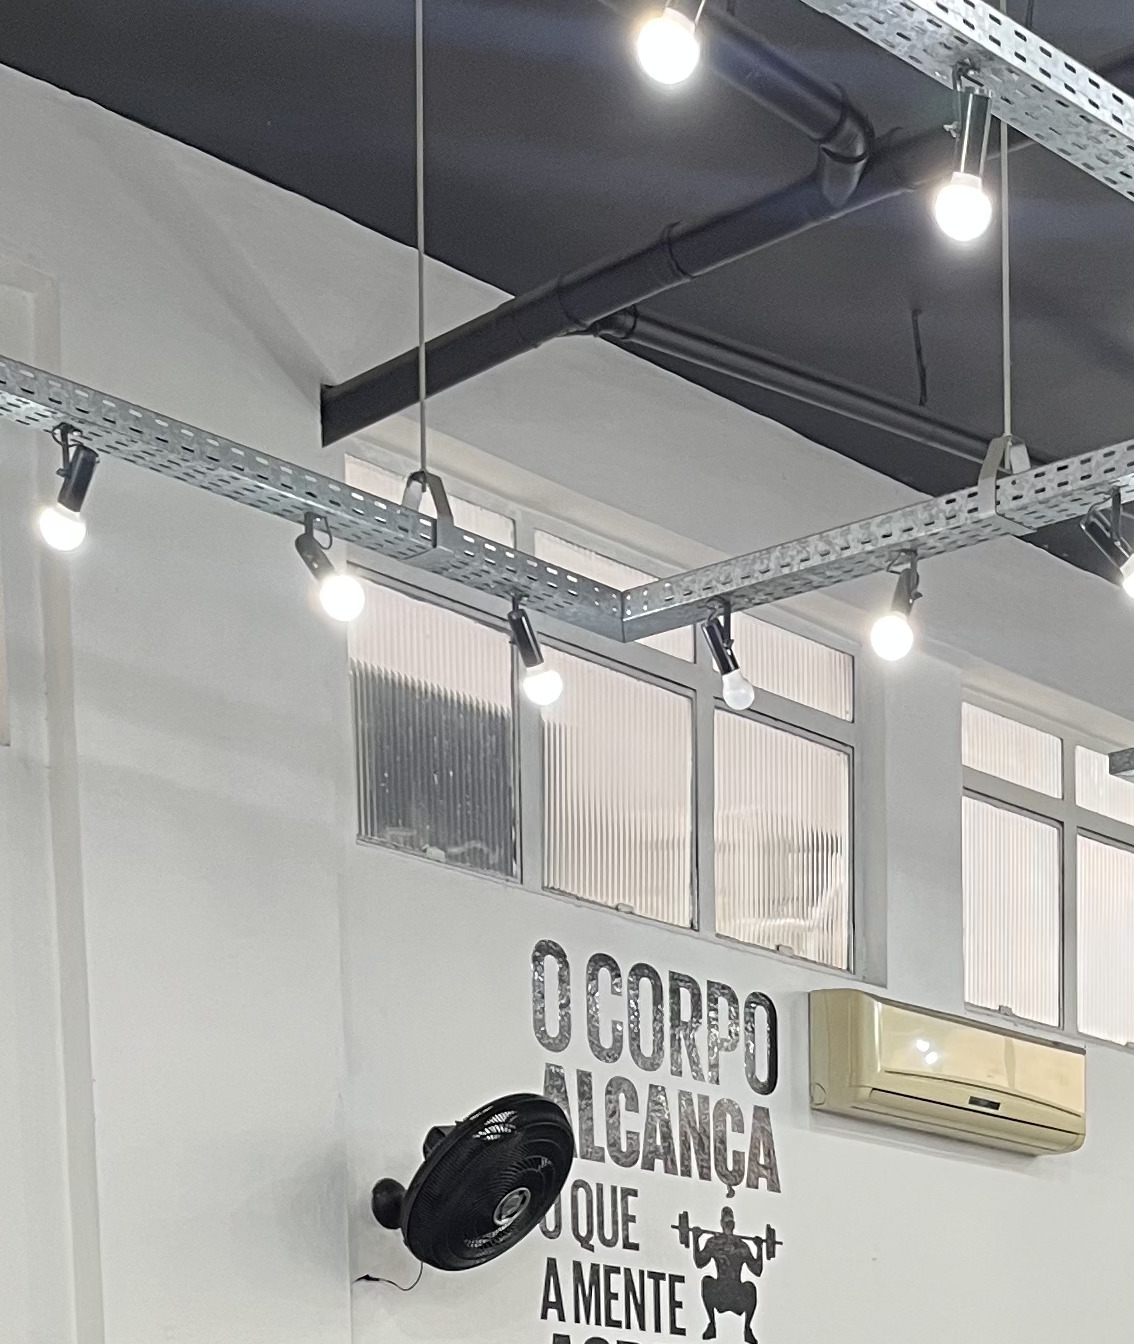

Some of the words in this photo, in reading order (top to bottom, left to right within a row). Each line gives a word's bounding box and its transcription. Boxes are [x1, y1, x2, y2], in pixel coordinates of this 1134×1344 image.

[531, 939, 572, 1053] O
[586, 952, 778, 1096] CORPO
[571, 1178, 640, 1253] QUE
[540, 1256, 566, 1323] A
[572, 1260, 686, 1337] MENTE
